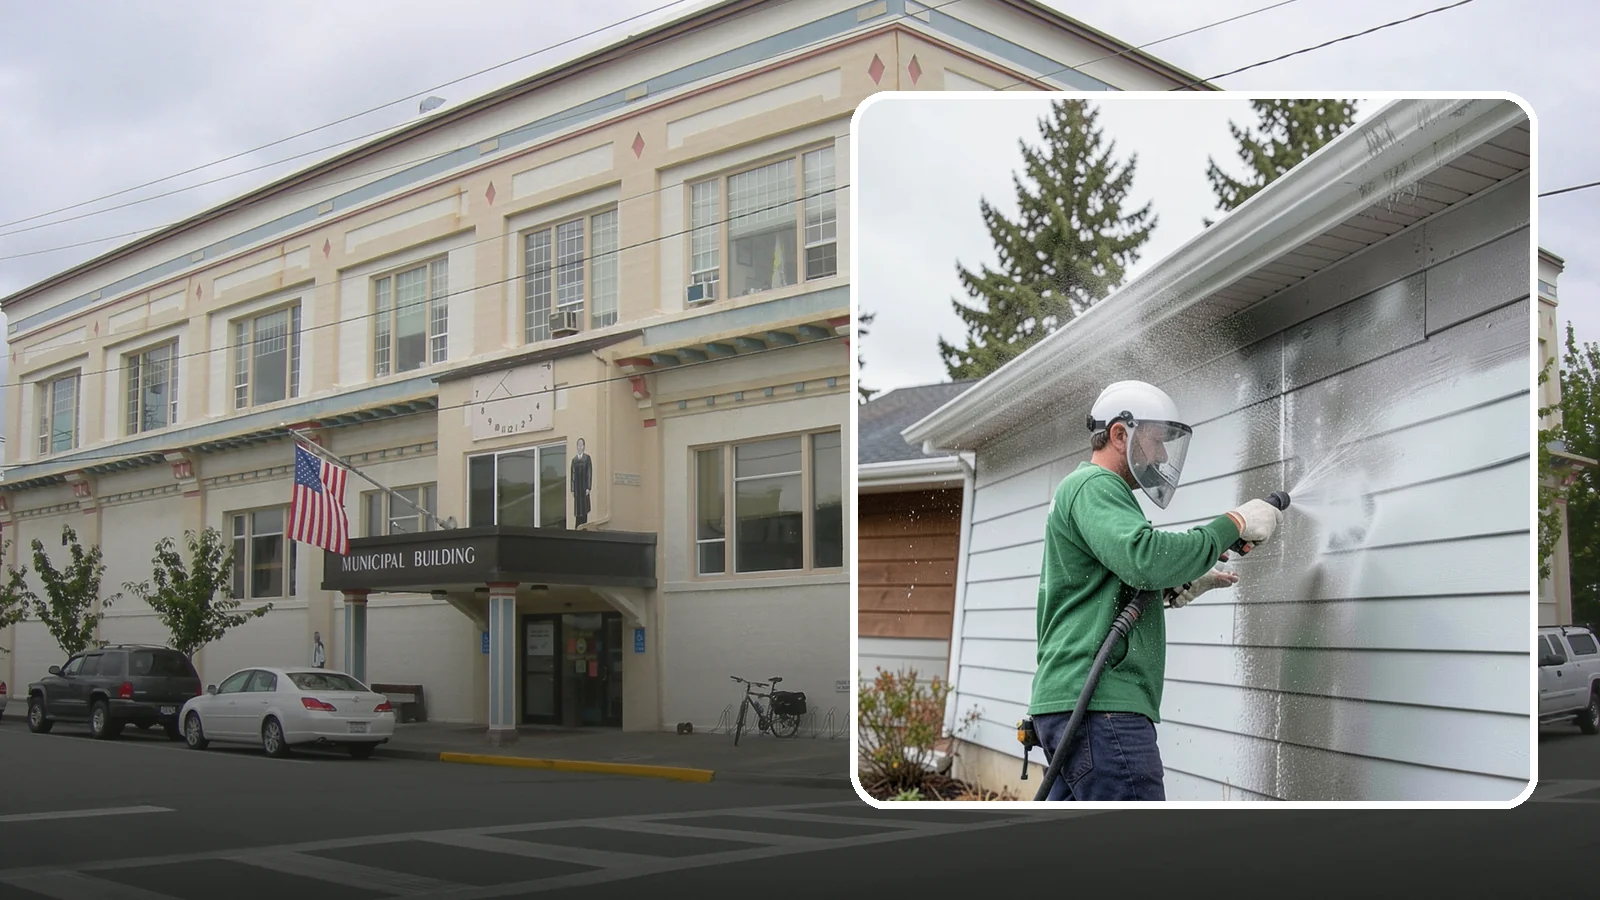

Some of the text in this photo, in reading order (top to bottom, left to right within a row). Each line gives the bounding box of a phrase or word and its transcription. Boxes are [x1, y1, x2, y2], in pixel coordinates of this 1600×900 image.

[481, 407, 485, 415] 8
[487, 417, 493, 426] 9
[494, 423, 500, 432] 10
[507, 425, 513, 433] 12
[521, 420, 526, 428] 2
[528, 413, 533, 422] 3
[536, 402, 540, 410] 4
[342, 546, 475, 572] MUNICIPAL BUILDING
